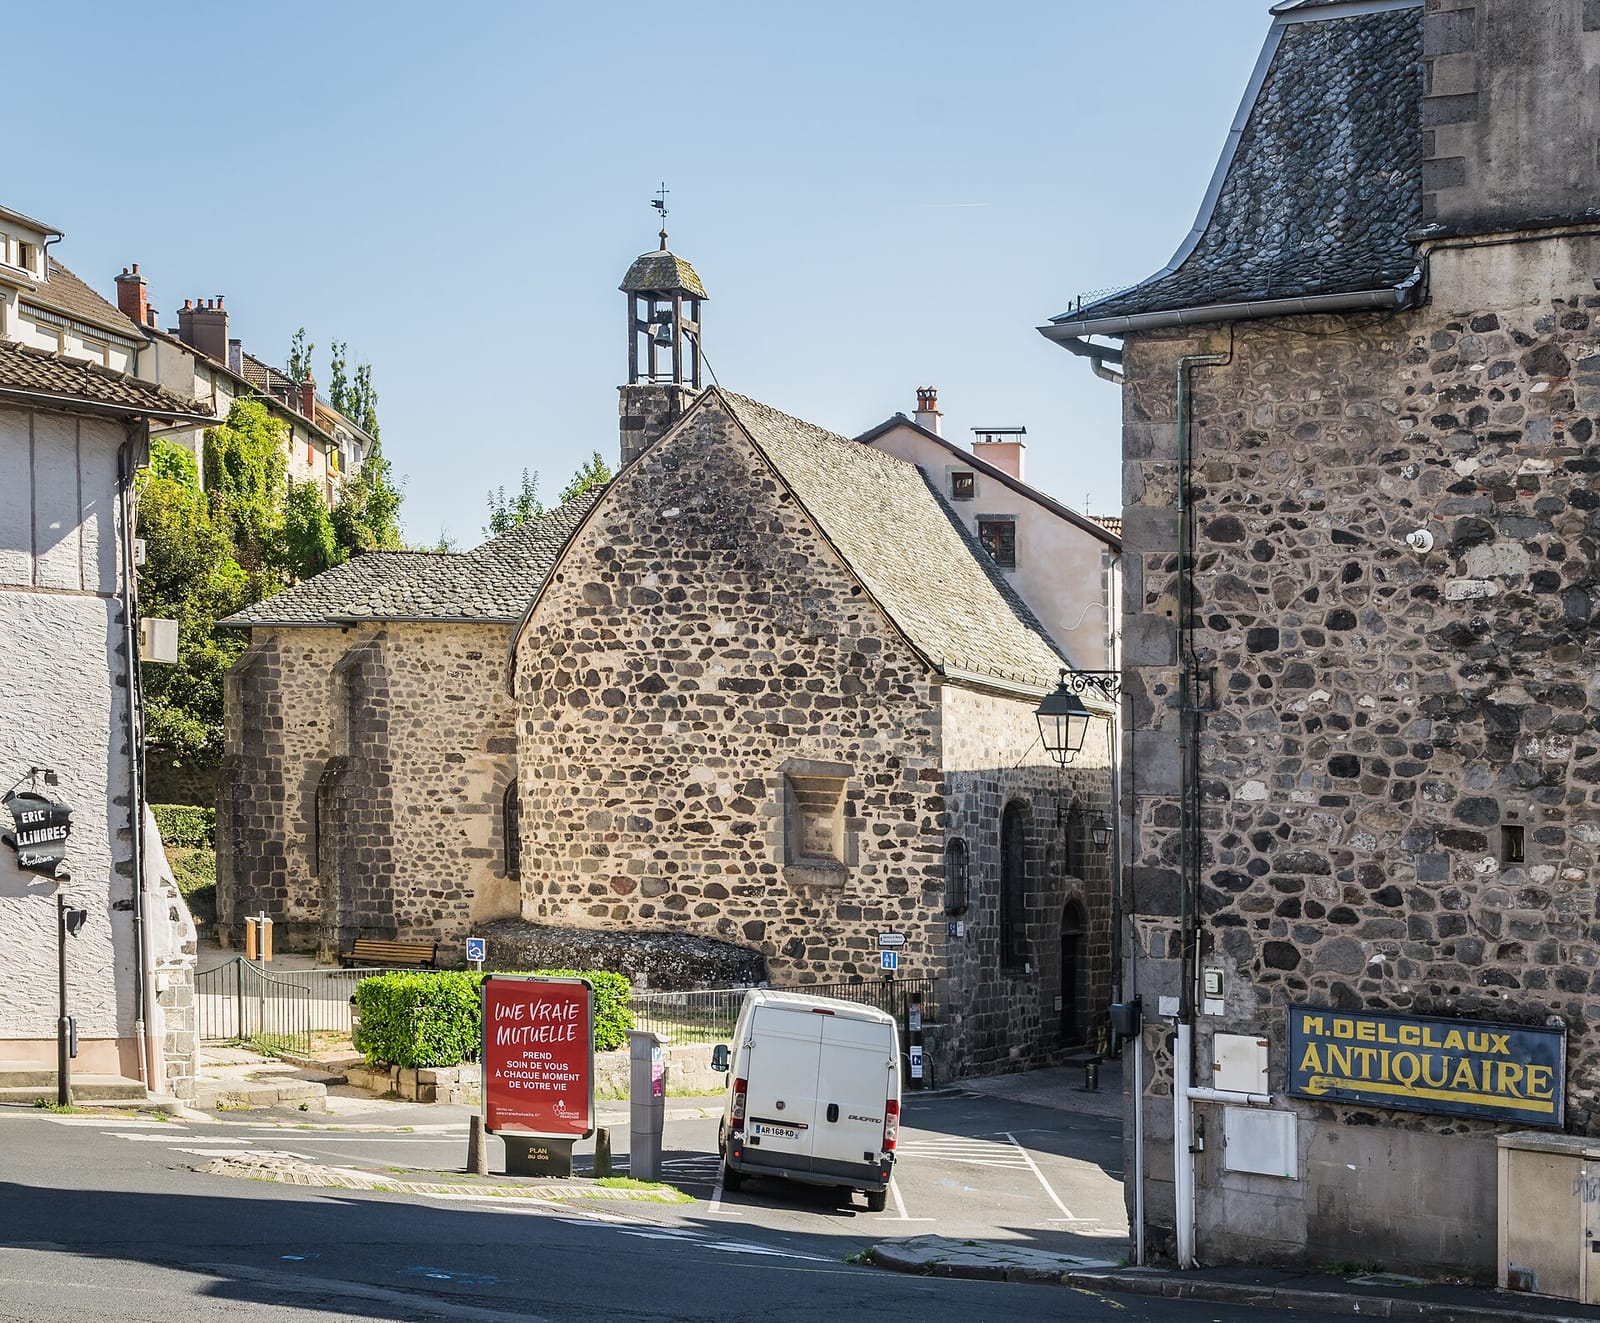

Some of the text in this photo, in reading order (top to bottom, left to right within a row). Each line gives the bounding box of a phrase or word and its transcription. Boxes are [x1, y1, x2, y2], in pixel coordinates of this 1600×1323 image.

[495, 1002, 525, 1021] UNE
[496, 1023, 578, 1045] MUTUELLE
[522, 1051, 552, 1060] PREND
[506, 1060, 569, 1071] SOIN DE VOUS
[1299, 1042, 1554, 1099] ANTIQUAIRE
[503, 1070, 540, 1080] CHAQUE
[542, 1072, 580, 1081] MOMENT
[508, 1081, 567, 1091] DE VOTRE VIE
[848, 1114, 882, 1124] DUCATO
